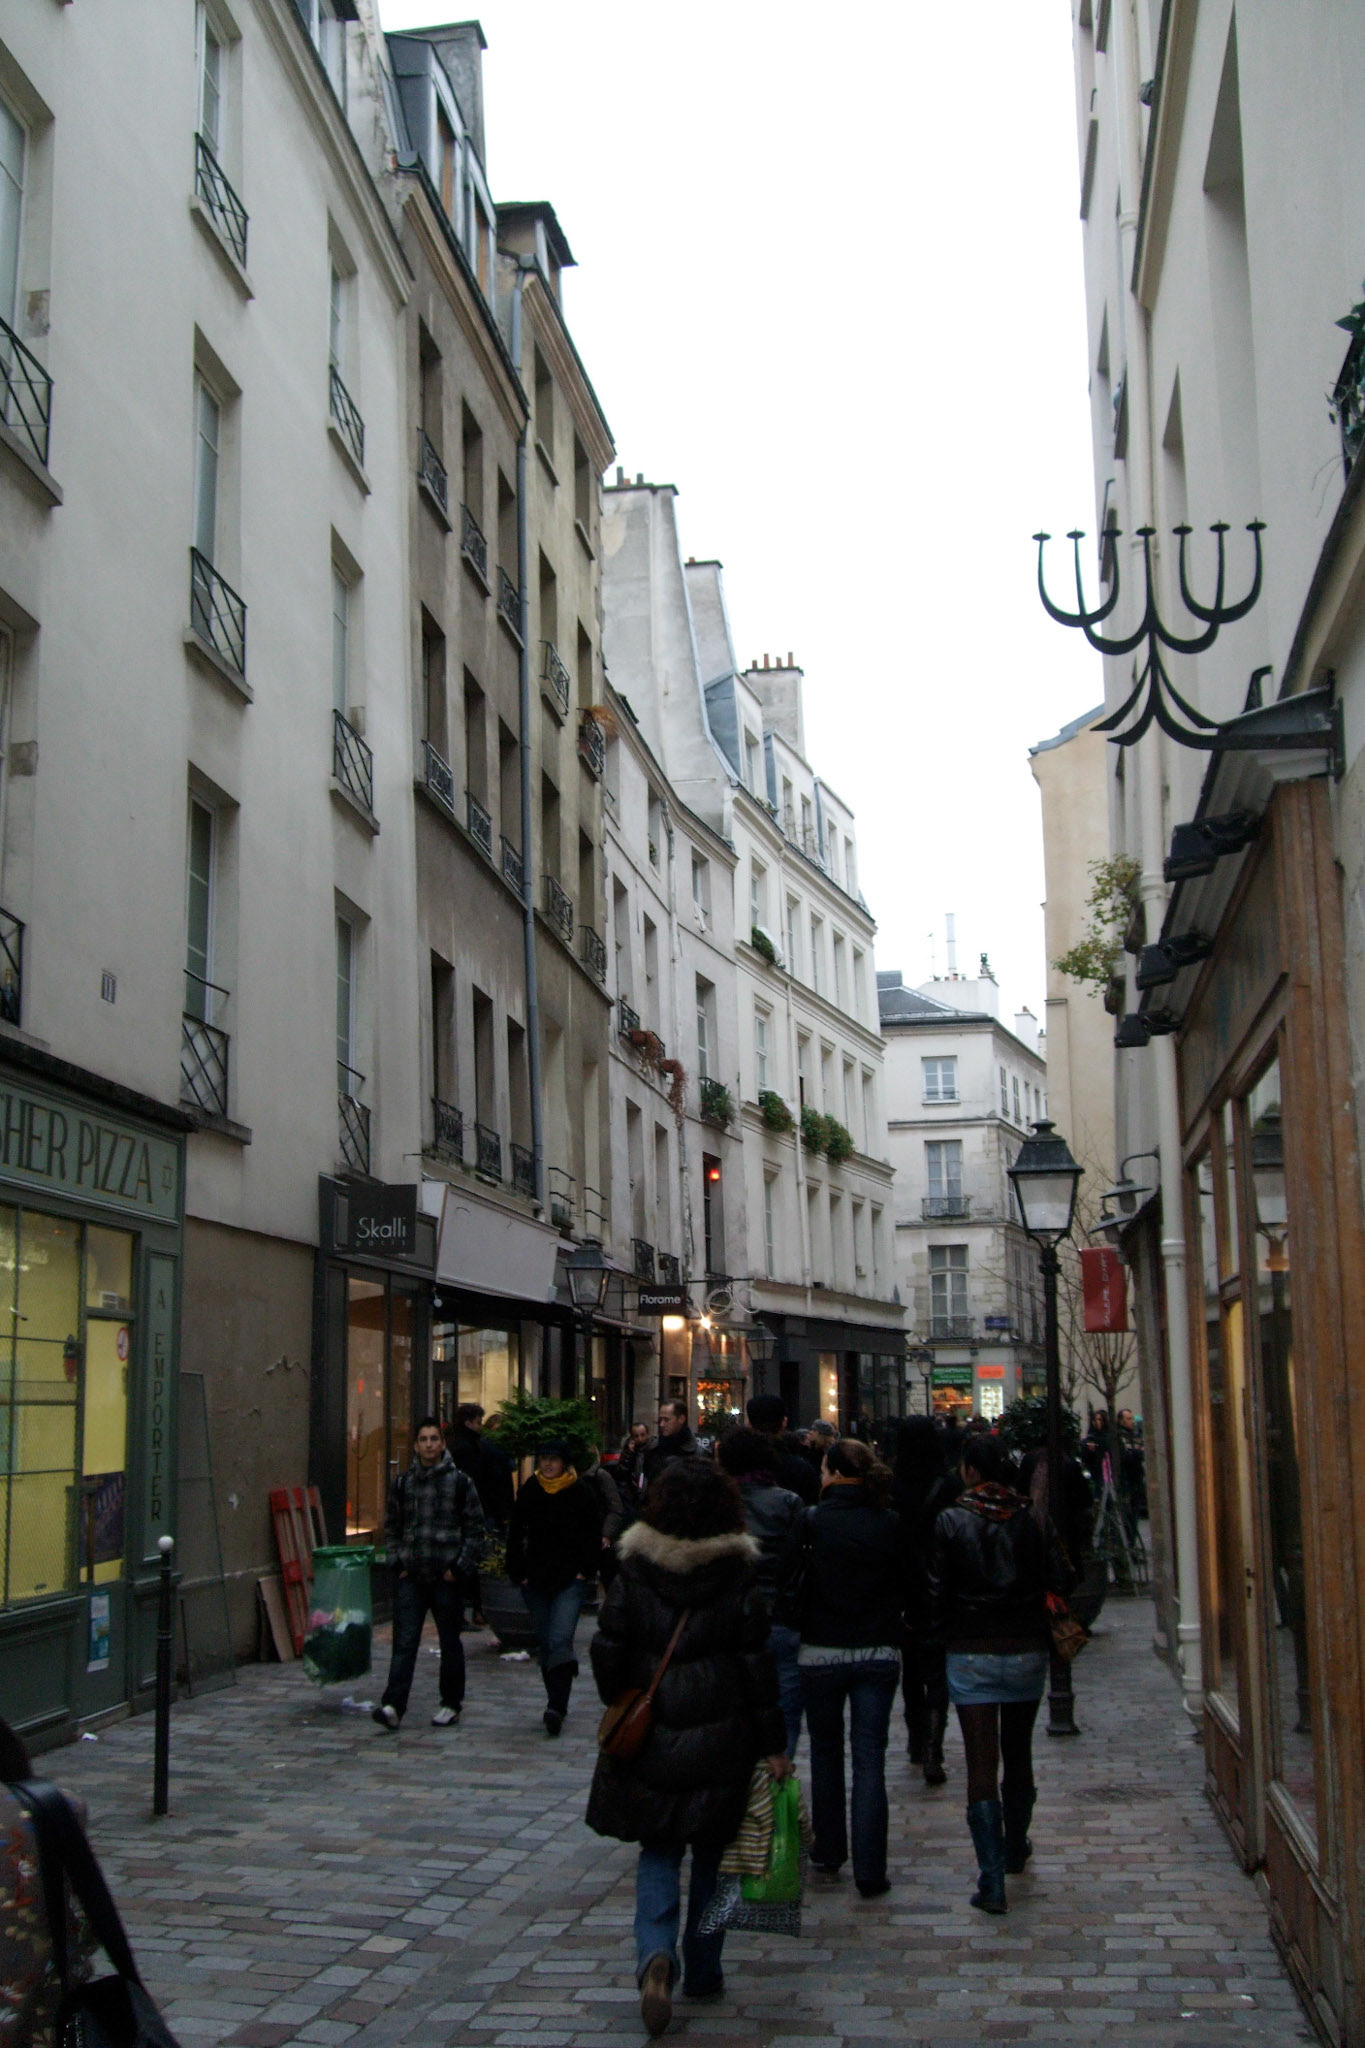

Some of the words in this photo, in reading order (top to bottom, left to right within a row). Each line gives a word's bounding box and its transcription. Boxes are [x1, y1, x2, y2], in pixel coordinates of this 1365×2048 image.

[0, 1093, 67, 1180] HER
[75, 1119, 153, 1204] PIZZA
[356, 1217, 406, 1239] Skalli
[640, 1294, 682, 1304] Florame
[151, 1333, 165, 1521] EMPORTER
